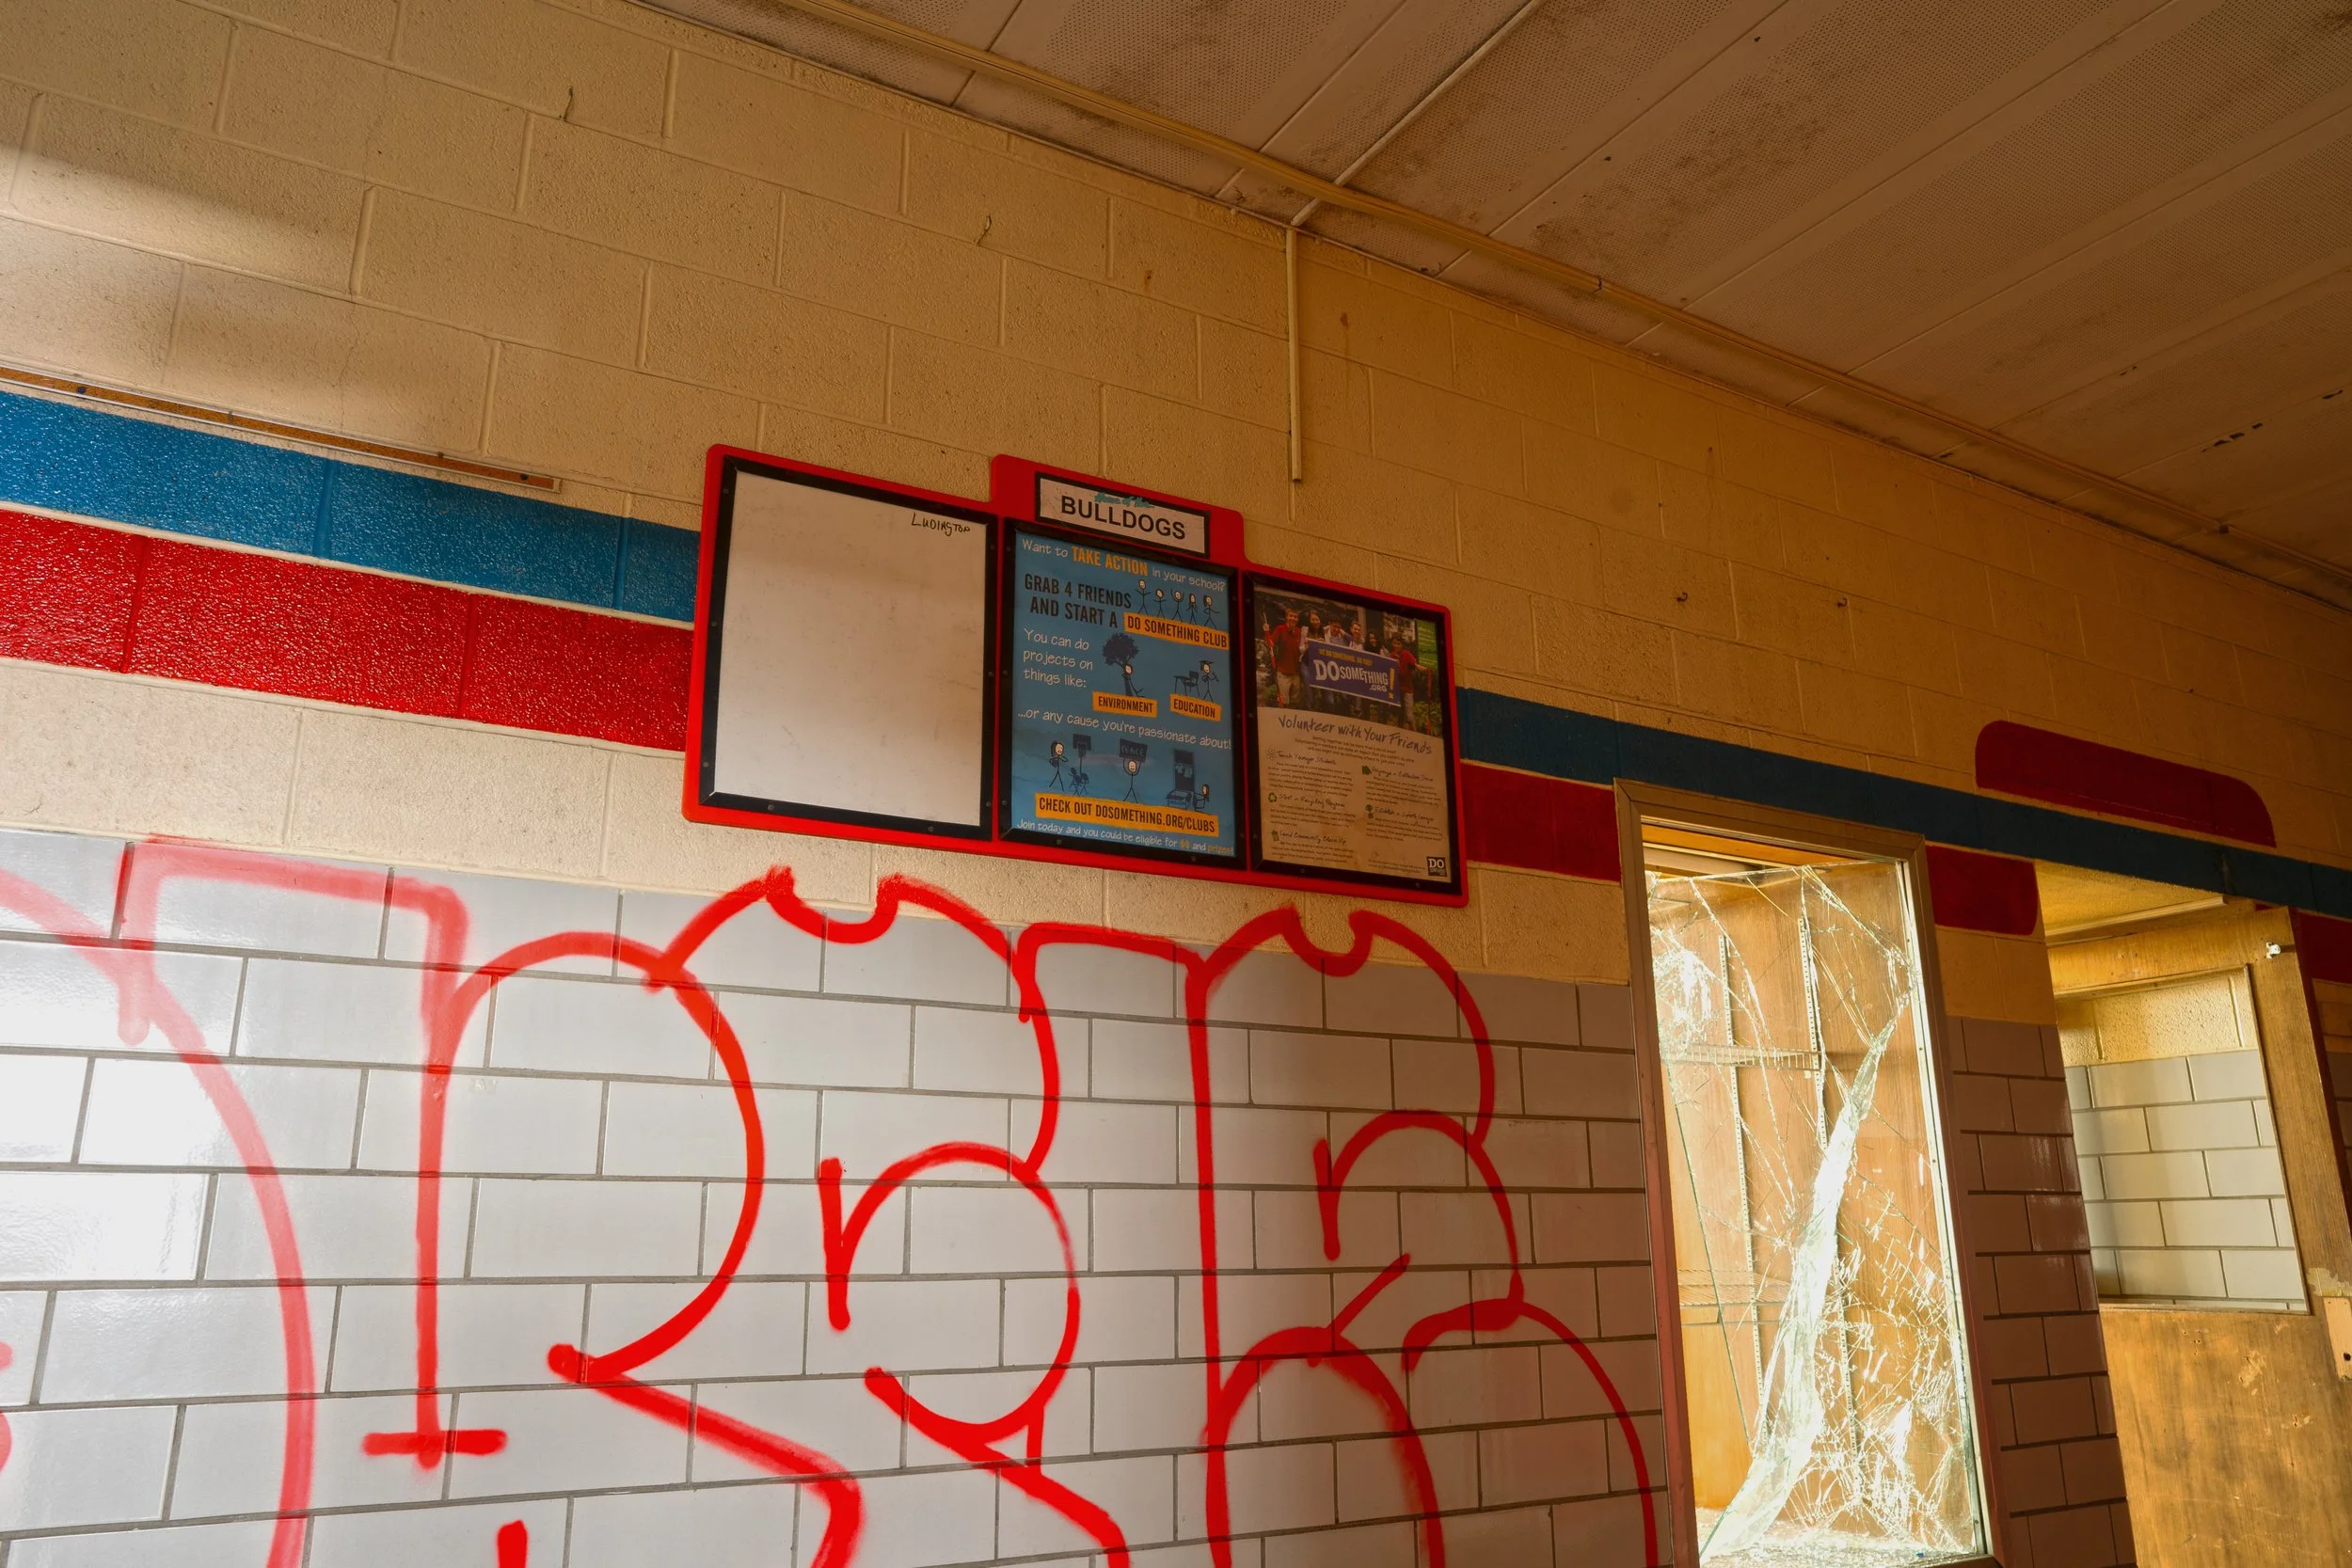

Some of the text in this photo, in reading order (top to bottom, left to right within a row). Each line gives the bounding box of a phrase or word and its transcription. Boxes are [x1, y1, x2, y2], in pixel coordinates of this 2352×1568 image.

[1060, 495, 1186, 540] BULLDOGS
[1022, 538, 1226, 593] Want to TAKE ACTION in your school?
[1025, 573, 1132, 610] GRAB 4 FRIENDS
[1030, 596, 1118, 628] AND START A
[1024, 627, 1089, 651] You can do
[1128, 614, 1228, 648] DO SOMETHING CLUB
[1023, 650, 1093, 671] projects on
[1024, 668, 1088, 689] things like:
[1098, 695, 1153, 714] ENVIRONMENT
[1173, 698, 1216, 719] EDUCATION
[1042, 710, 1063, 724] any
[1067, 715, 1100, 728] cause
[1103, 719, 1136, 734] you're
[1138, 725, 1197, 745] passionate
[1200, 735, 1232, 751] about!
[1278, 714, 1335, 733] Volunteer
[1338, 723, 1361, 738] with
[1363, 725, 1389, 742] Your
[1389, 732, 1432, 754] Friends
[1039, 797, 1216, 833] CHECK OUT DOSOMETHING.ORG/CLUBS
[1017, 818, 1036, 830] Join
[1037, 821, 1063, 834] today
[1066, 825, 1081, 836] and
[1083, 828, 1099, 839] you
[1100, 829, 1122, 841] could
[1123, 832, 1134, 842] be
[1135, 832, 1163, 847] eligible
[1165, 836, 1178, 847] for
[1192, 842, 1206, 851] and
[1428, 858, 1445, 869] DO
